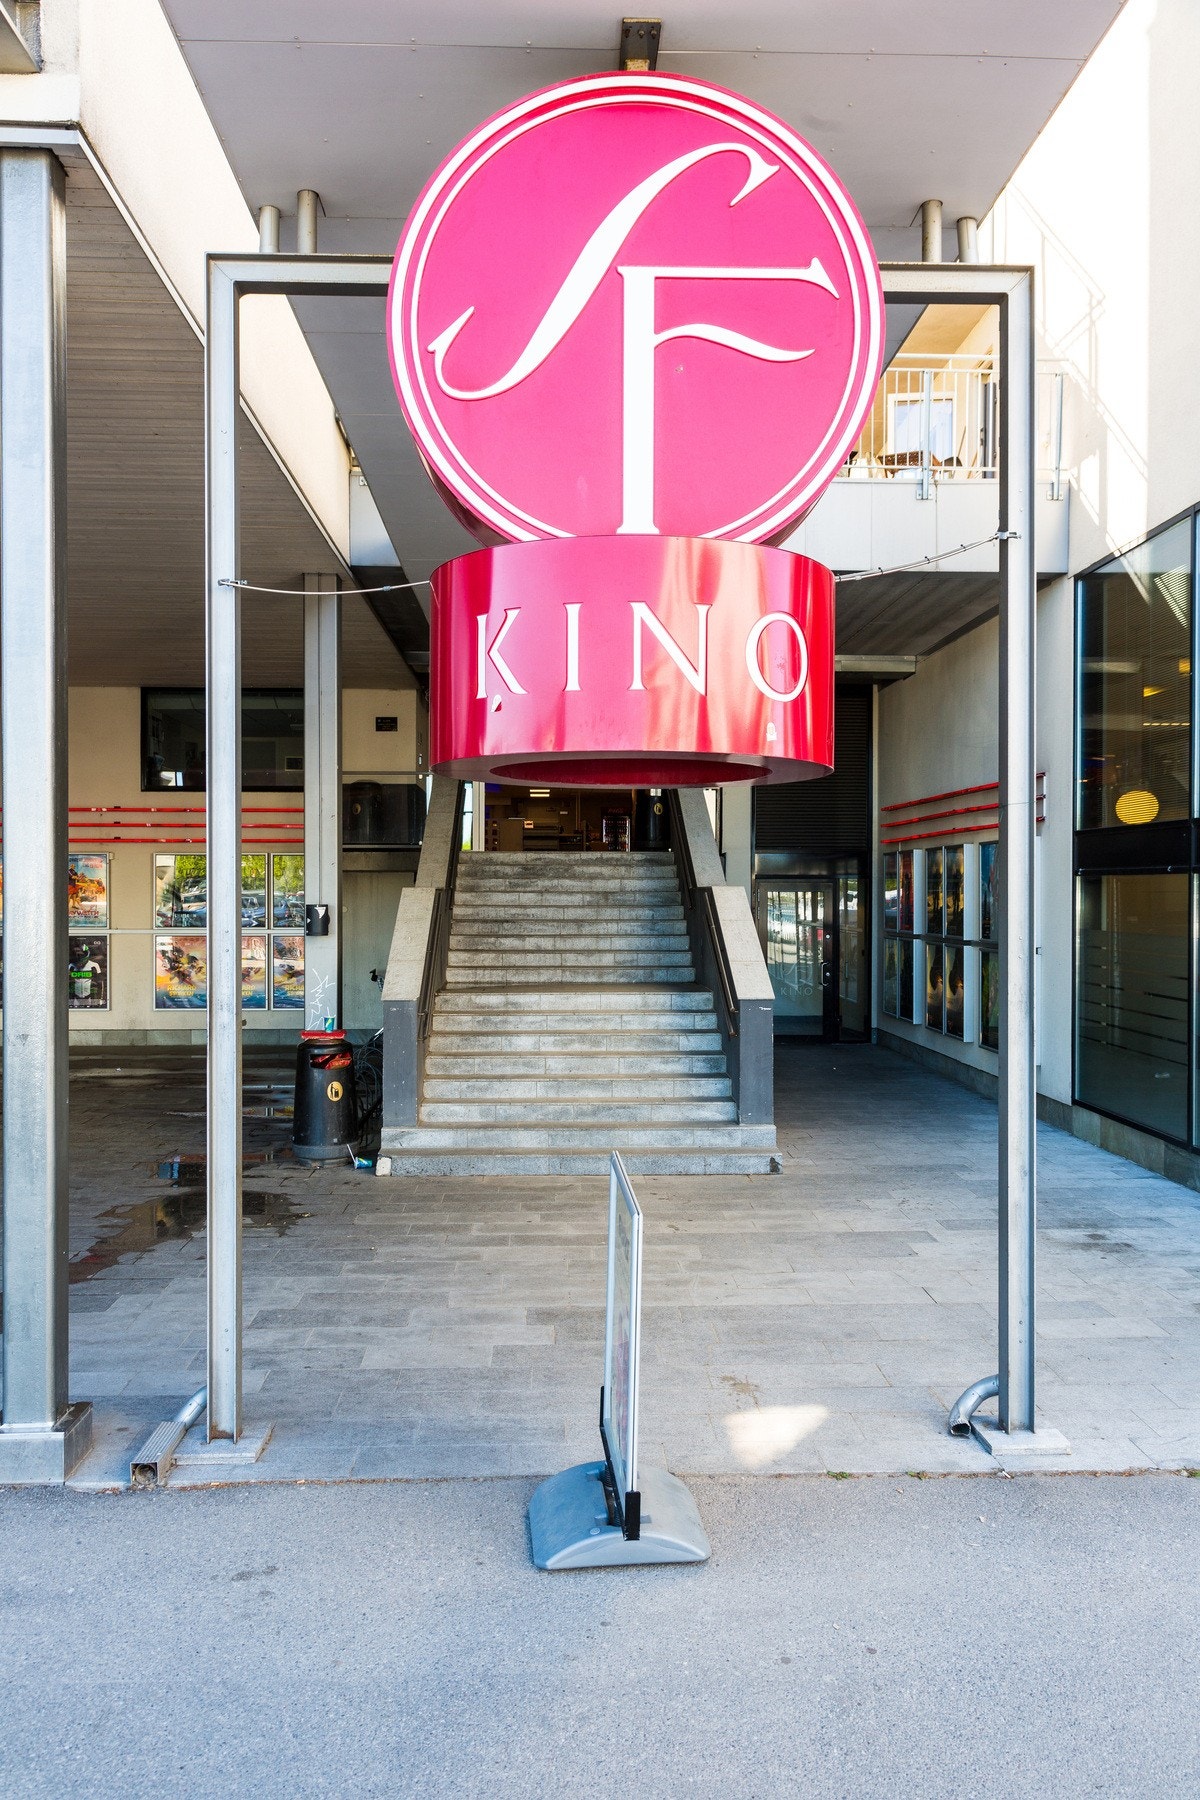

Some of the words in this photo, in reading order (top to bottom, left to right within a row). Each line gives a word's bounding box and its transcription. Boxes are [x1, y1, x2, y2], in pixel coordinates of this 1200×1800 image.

[427, 142, 840, 536] SF
[475, 600, 809, 703] KINO
[780, 987, 813, 996] KINO
